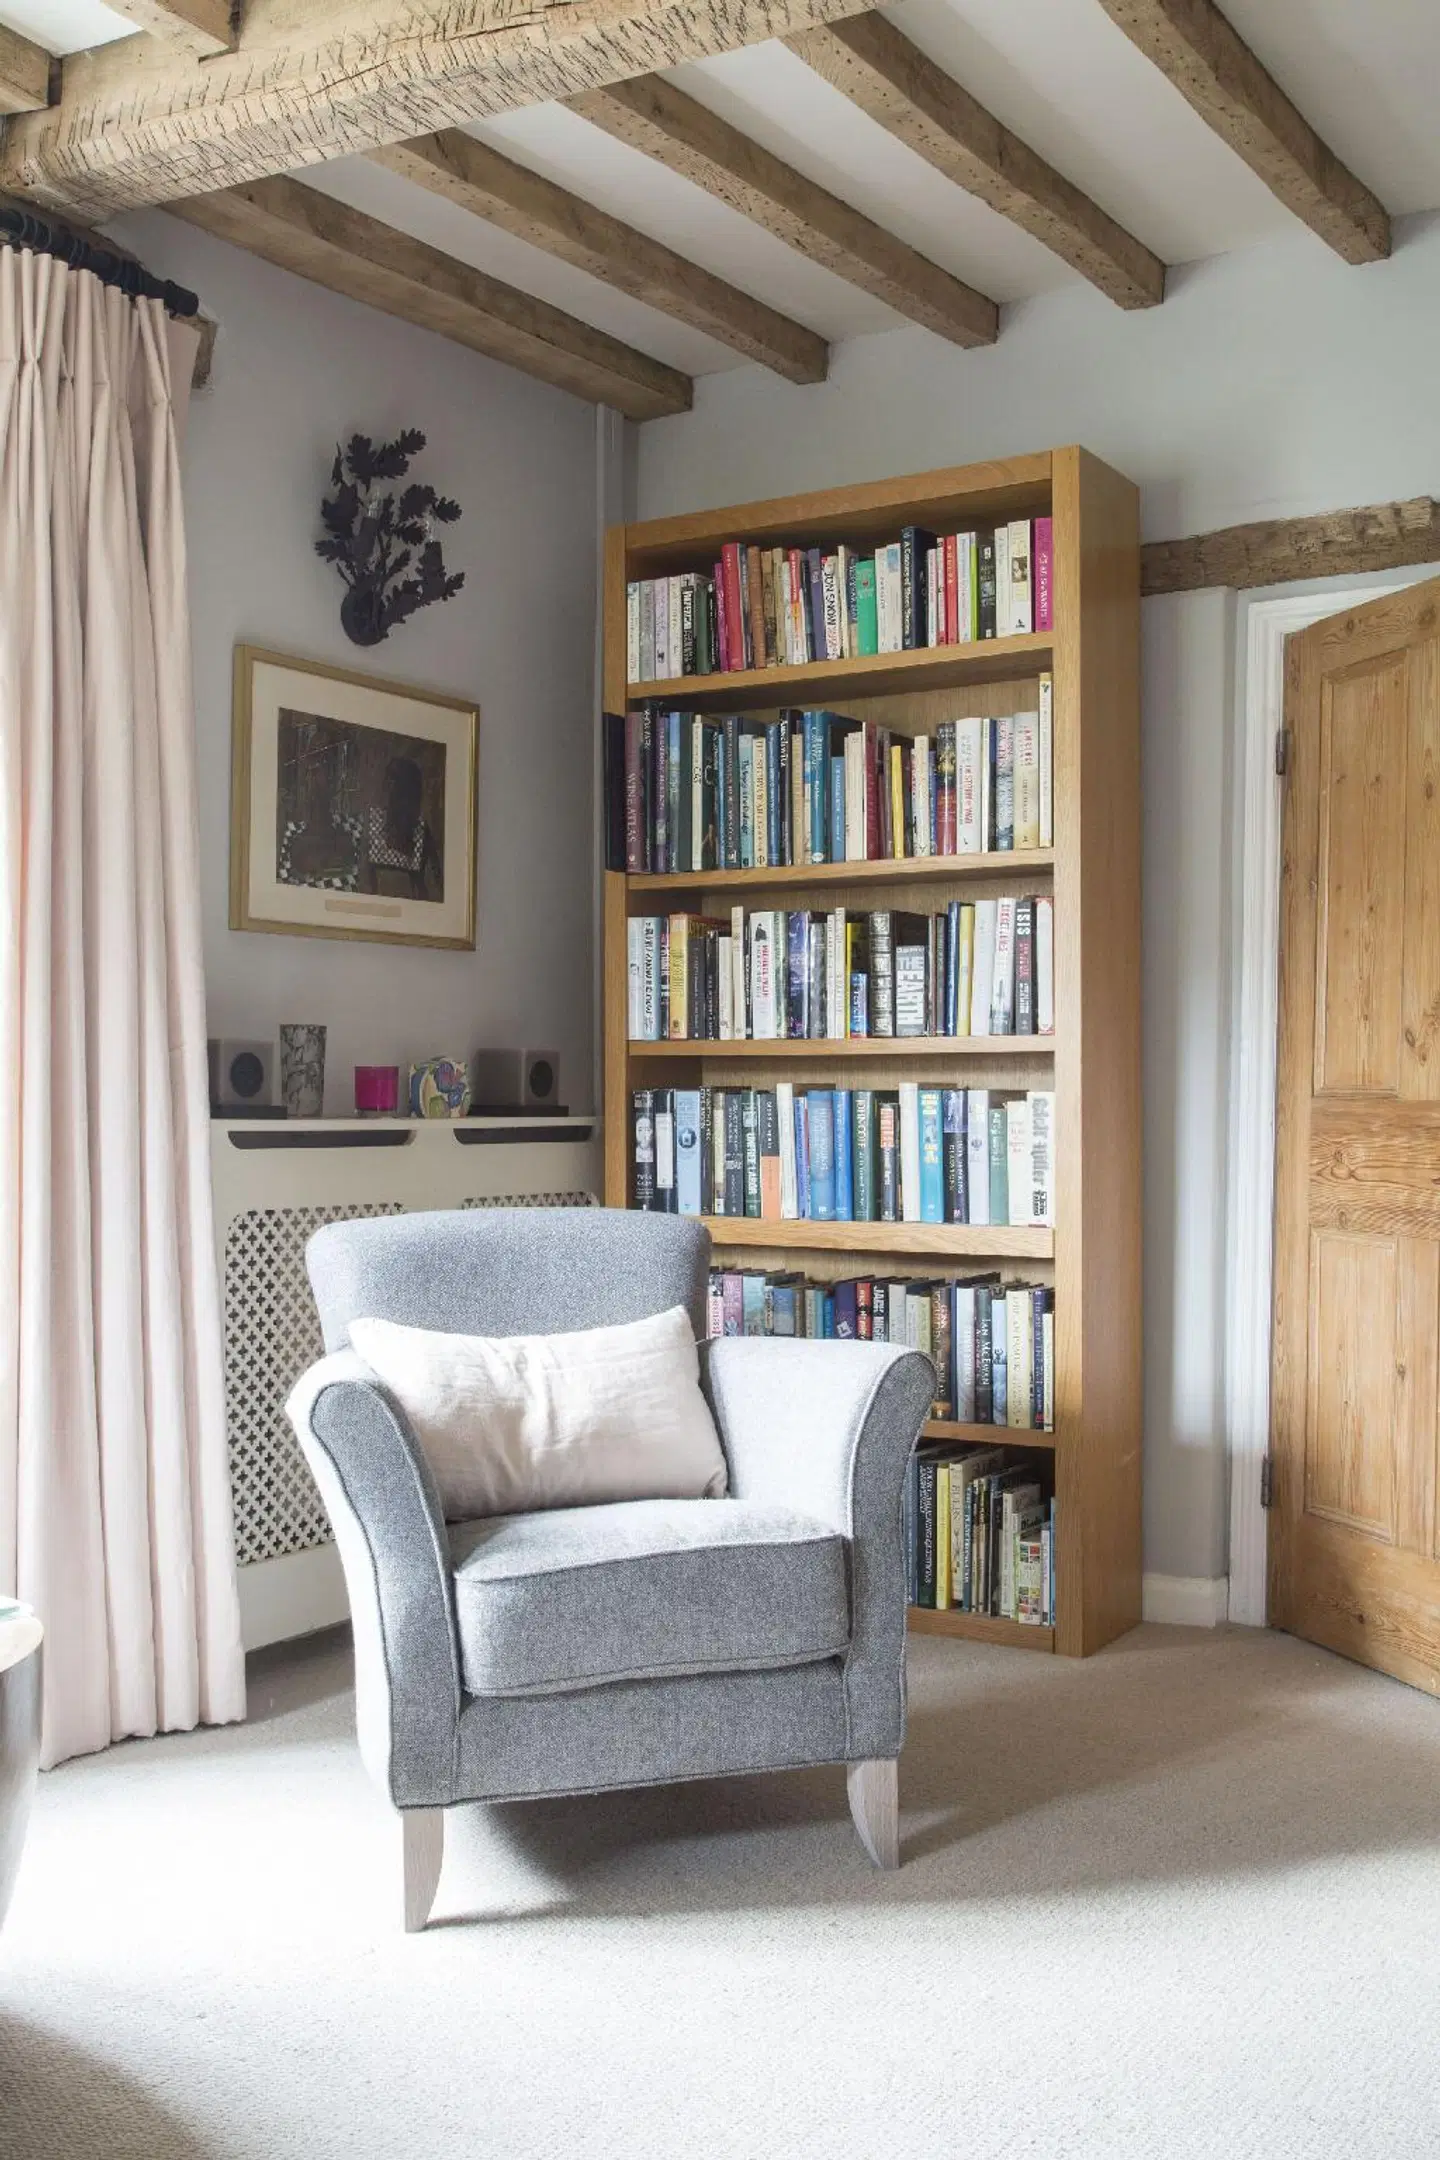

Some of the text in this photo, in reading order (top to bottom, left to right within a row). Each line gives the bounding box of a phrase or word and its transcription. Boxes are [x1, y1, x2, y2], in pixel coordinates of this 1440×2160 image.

[825, 572, 836, 592] JON
[825, 594, 837, 626] SNOW
[780, 719, 789, 768] Auschwitz
[627, 773, 637, 843] WINE ATLAS
[1017, 908, 1031, 935] ISIS
[898, 956, 924, 971] THE
[896, 970, 924, 1025] EARTH
[855, 1100, 866, 1123] JOHN
[873, 1285, 885, 1313] JACK
